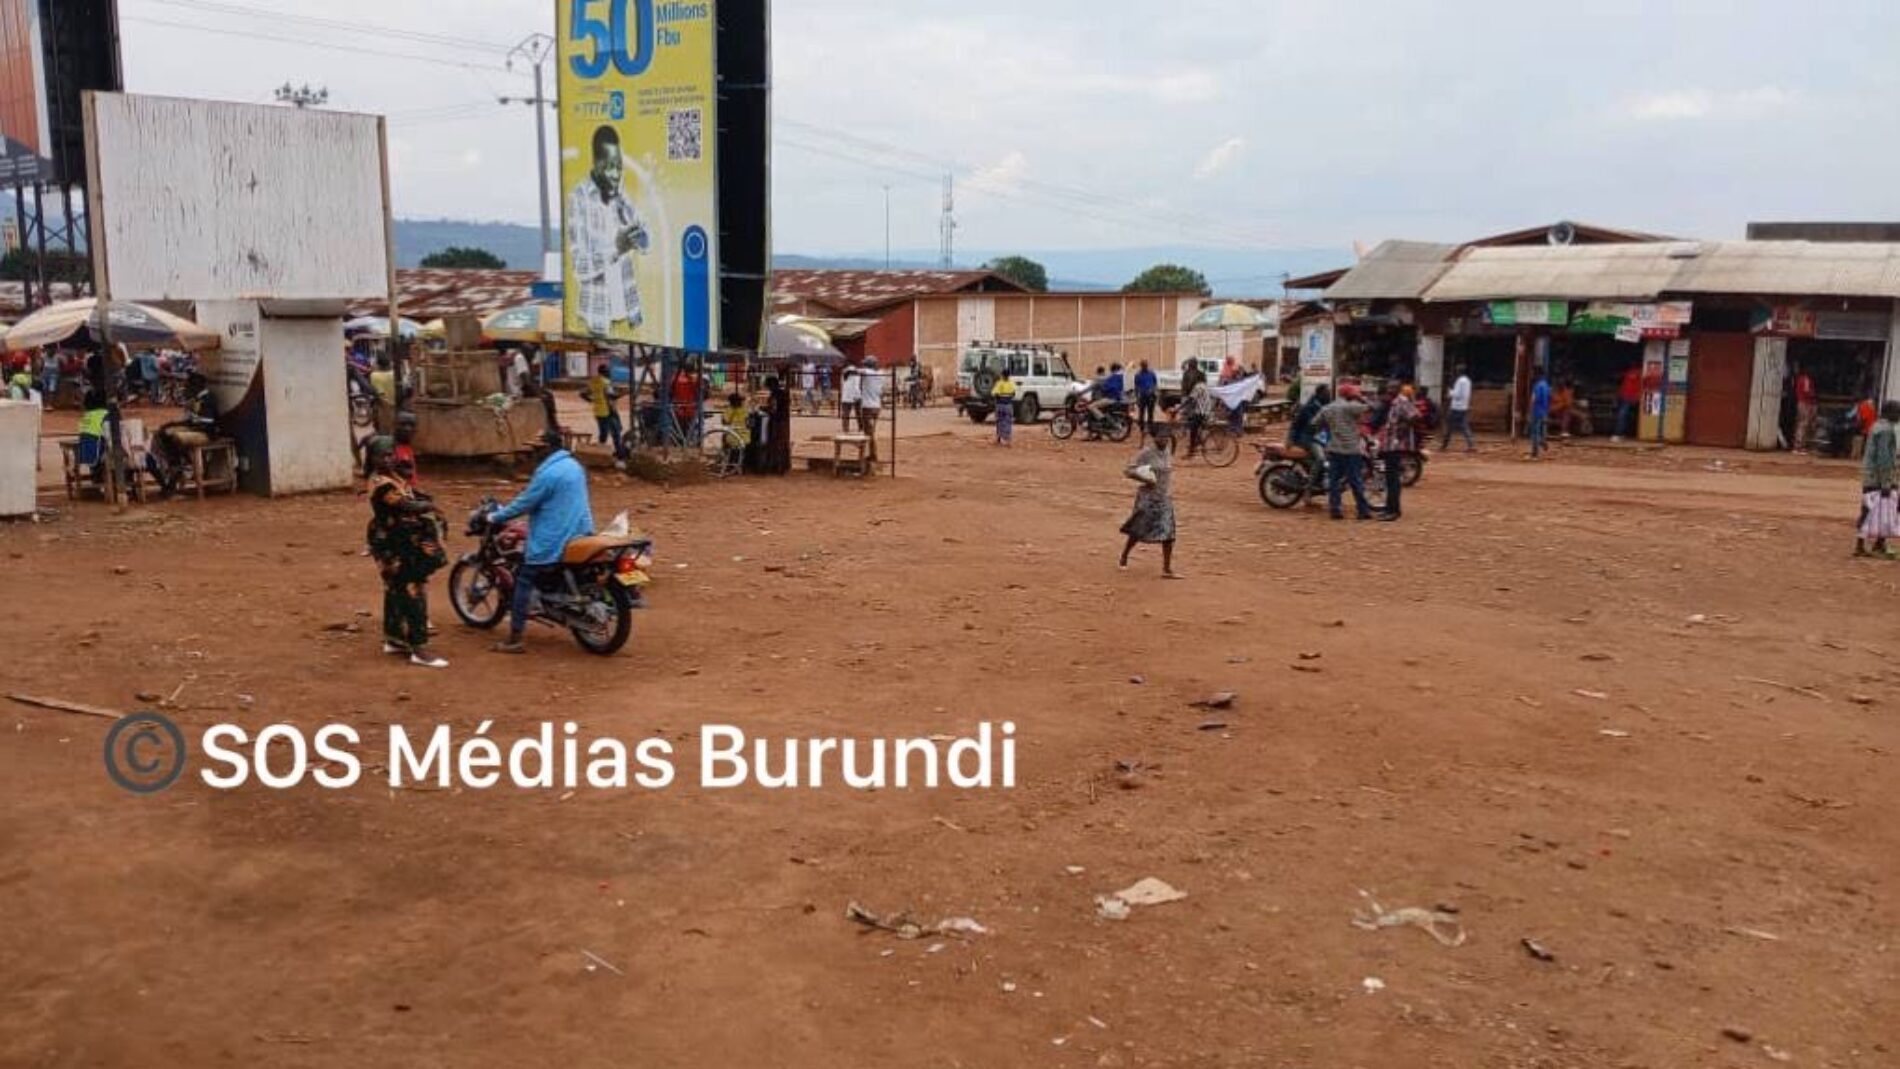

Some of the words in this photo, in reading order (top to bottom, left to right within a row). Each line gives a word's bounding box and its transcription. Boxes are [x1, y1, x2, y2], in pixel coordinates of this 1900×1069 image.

[656, 2, 708, 23] Millions
[569, 0, 655, 78] 50
[656, 28, 681, 46] Fbu
